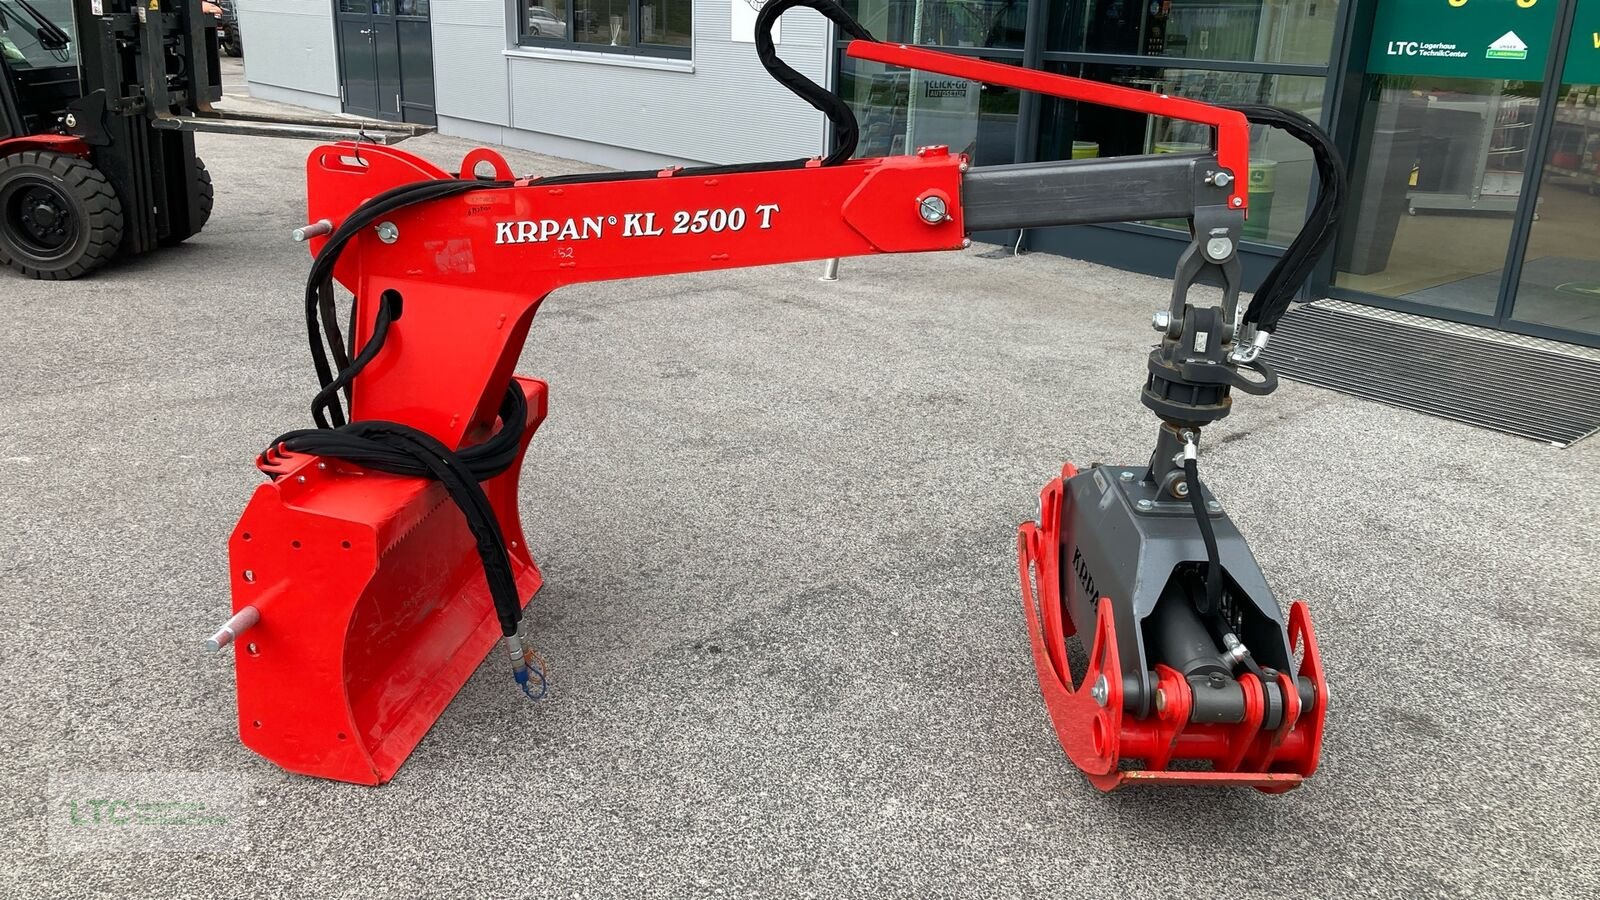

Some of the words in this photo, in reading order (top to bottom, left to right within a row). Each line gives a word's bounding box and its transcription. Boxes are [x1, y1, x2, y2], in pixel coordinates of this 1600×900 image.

[1387, 41, 1419, 56] LTC
[1420, 42, 1456, 50] Lagerhaus
[622, 212, 664, 237] KL
[672, 207, 746, 234] 2500
[755, 203, 780, 229] T
